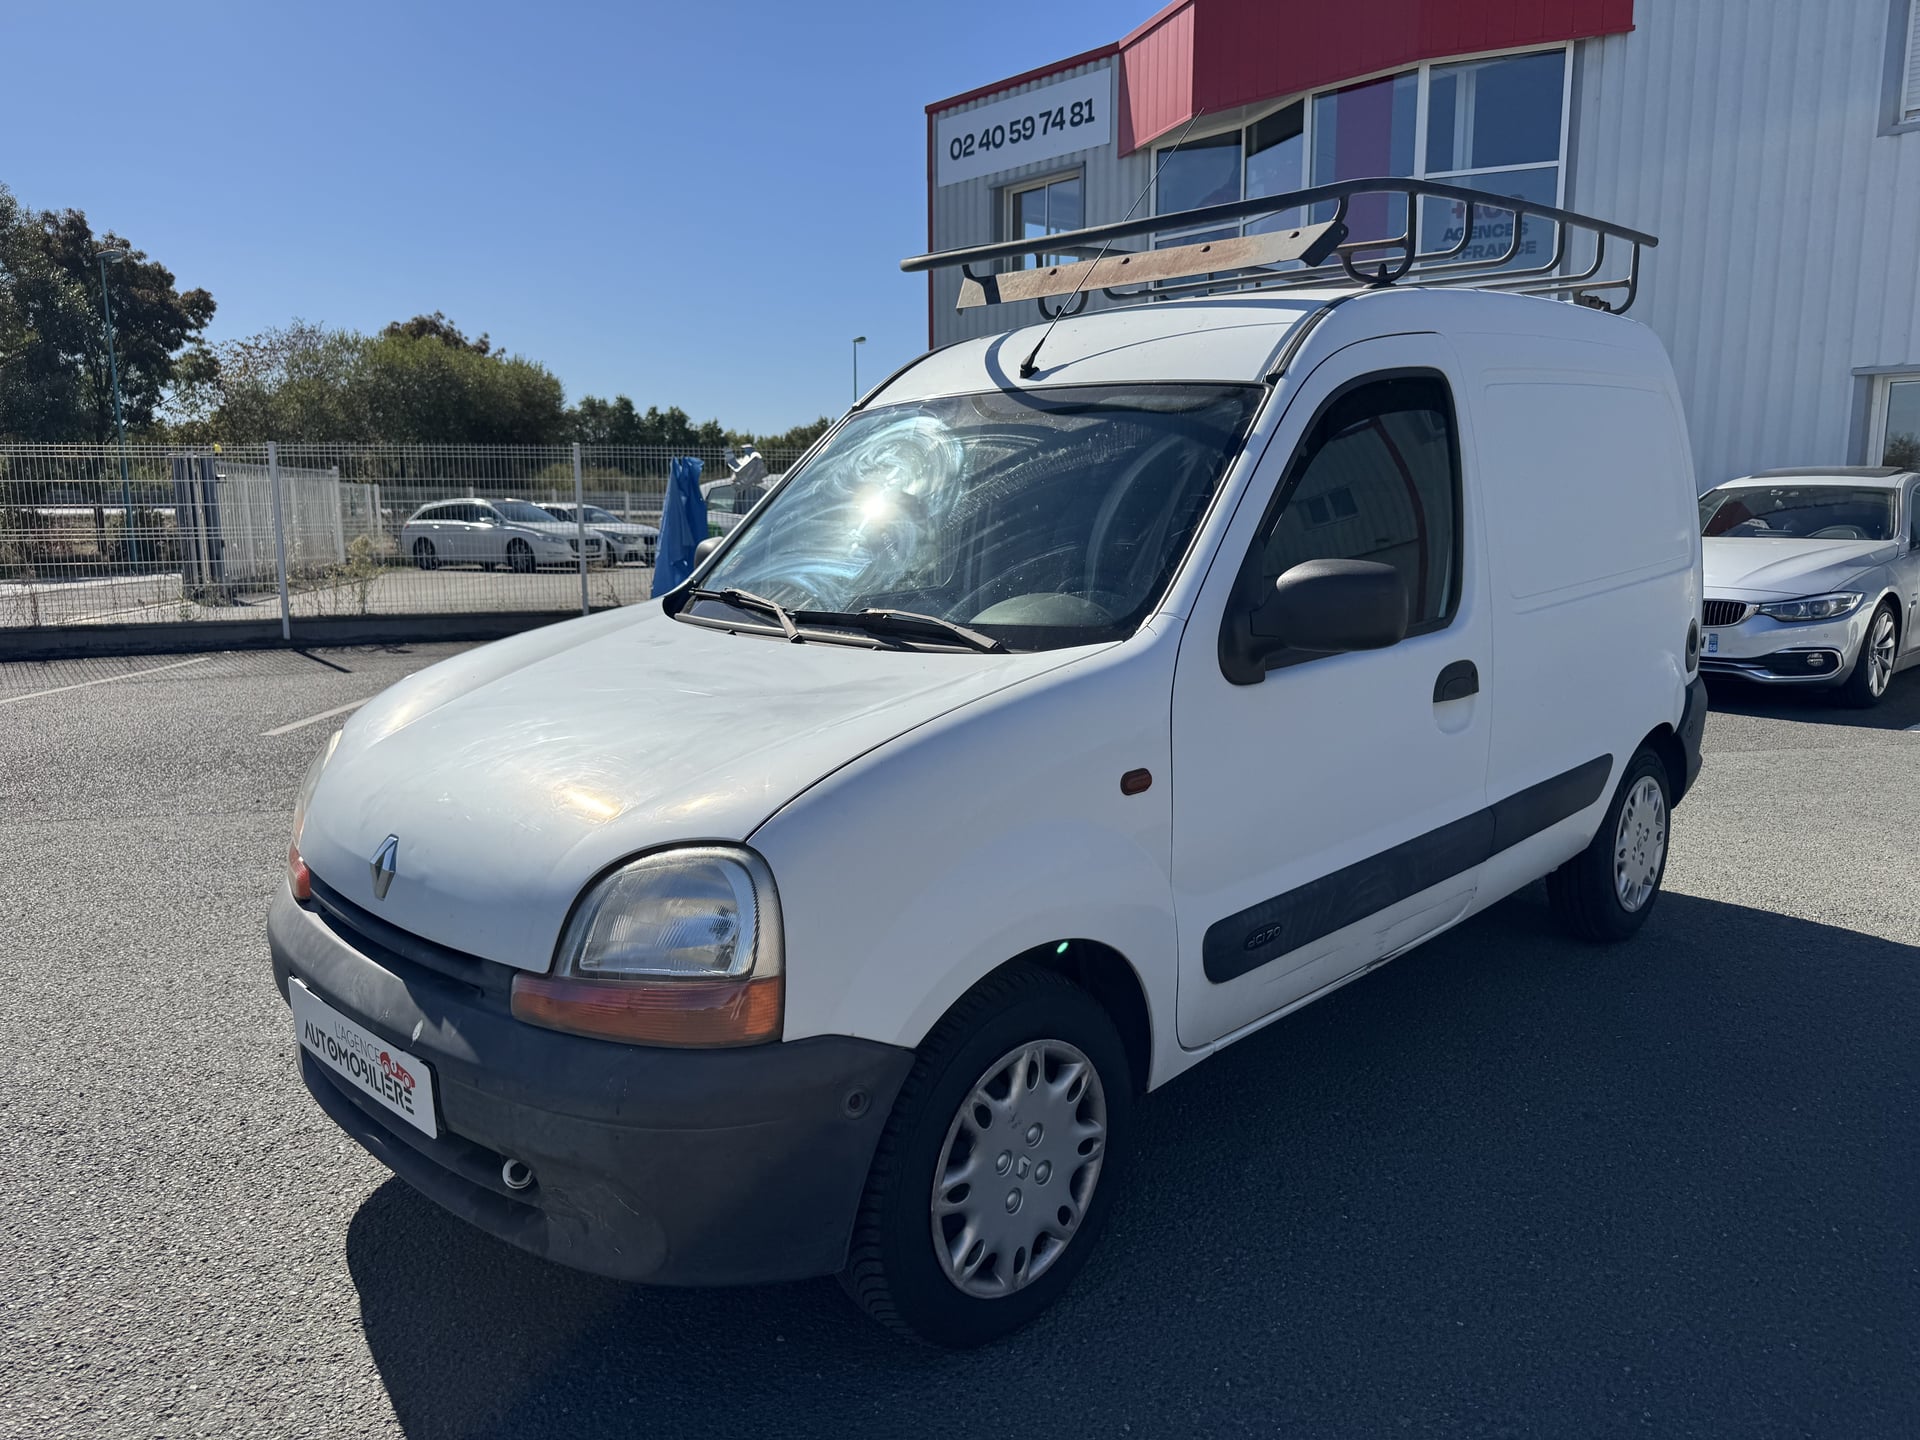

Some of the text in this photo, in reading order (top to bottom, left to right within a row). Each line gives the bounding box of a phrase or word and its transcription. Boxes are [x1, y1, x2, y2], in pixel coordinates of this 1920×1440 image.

[950, 98, 1095, 160] 02 40 59 74 81
[334, 1021, 380, 1065] L'AGENCE
